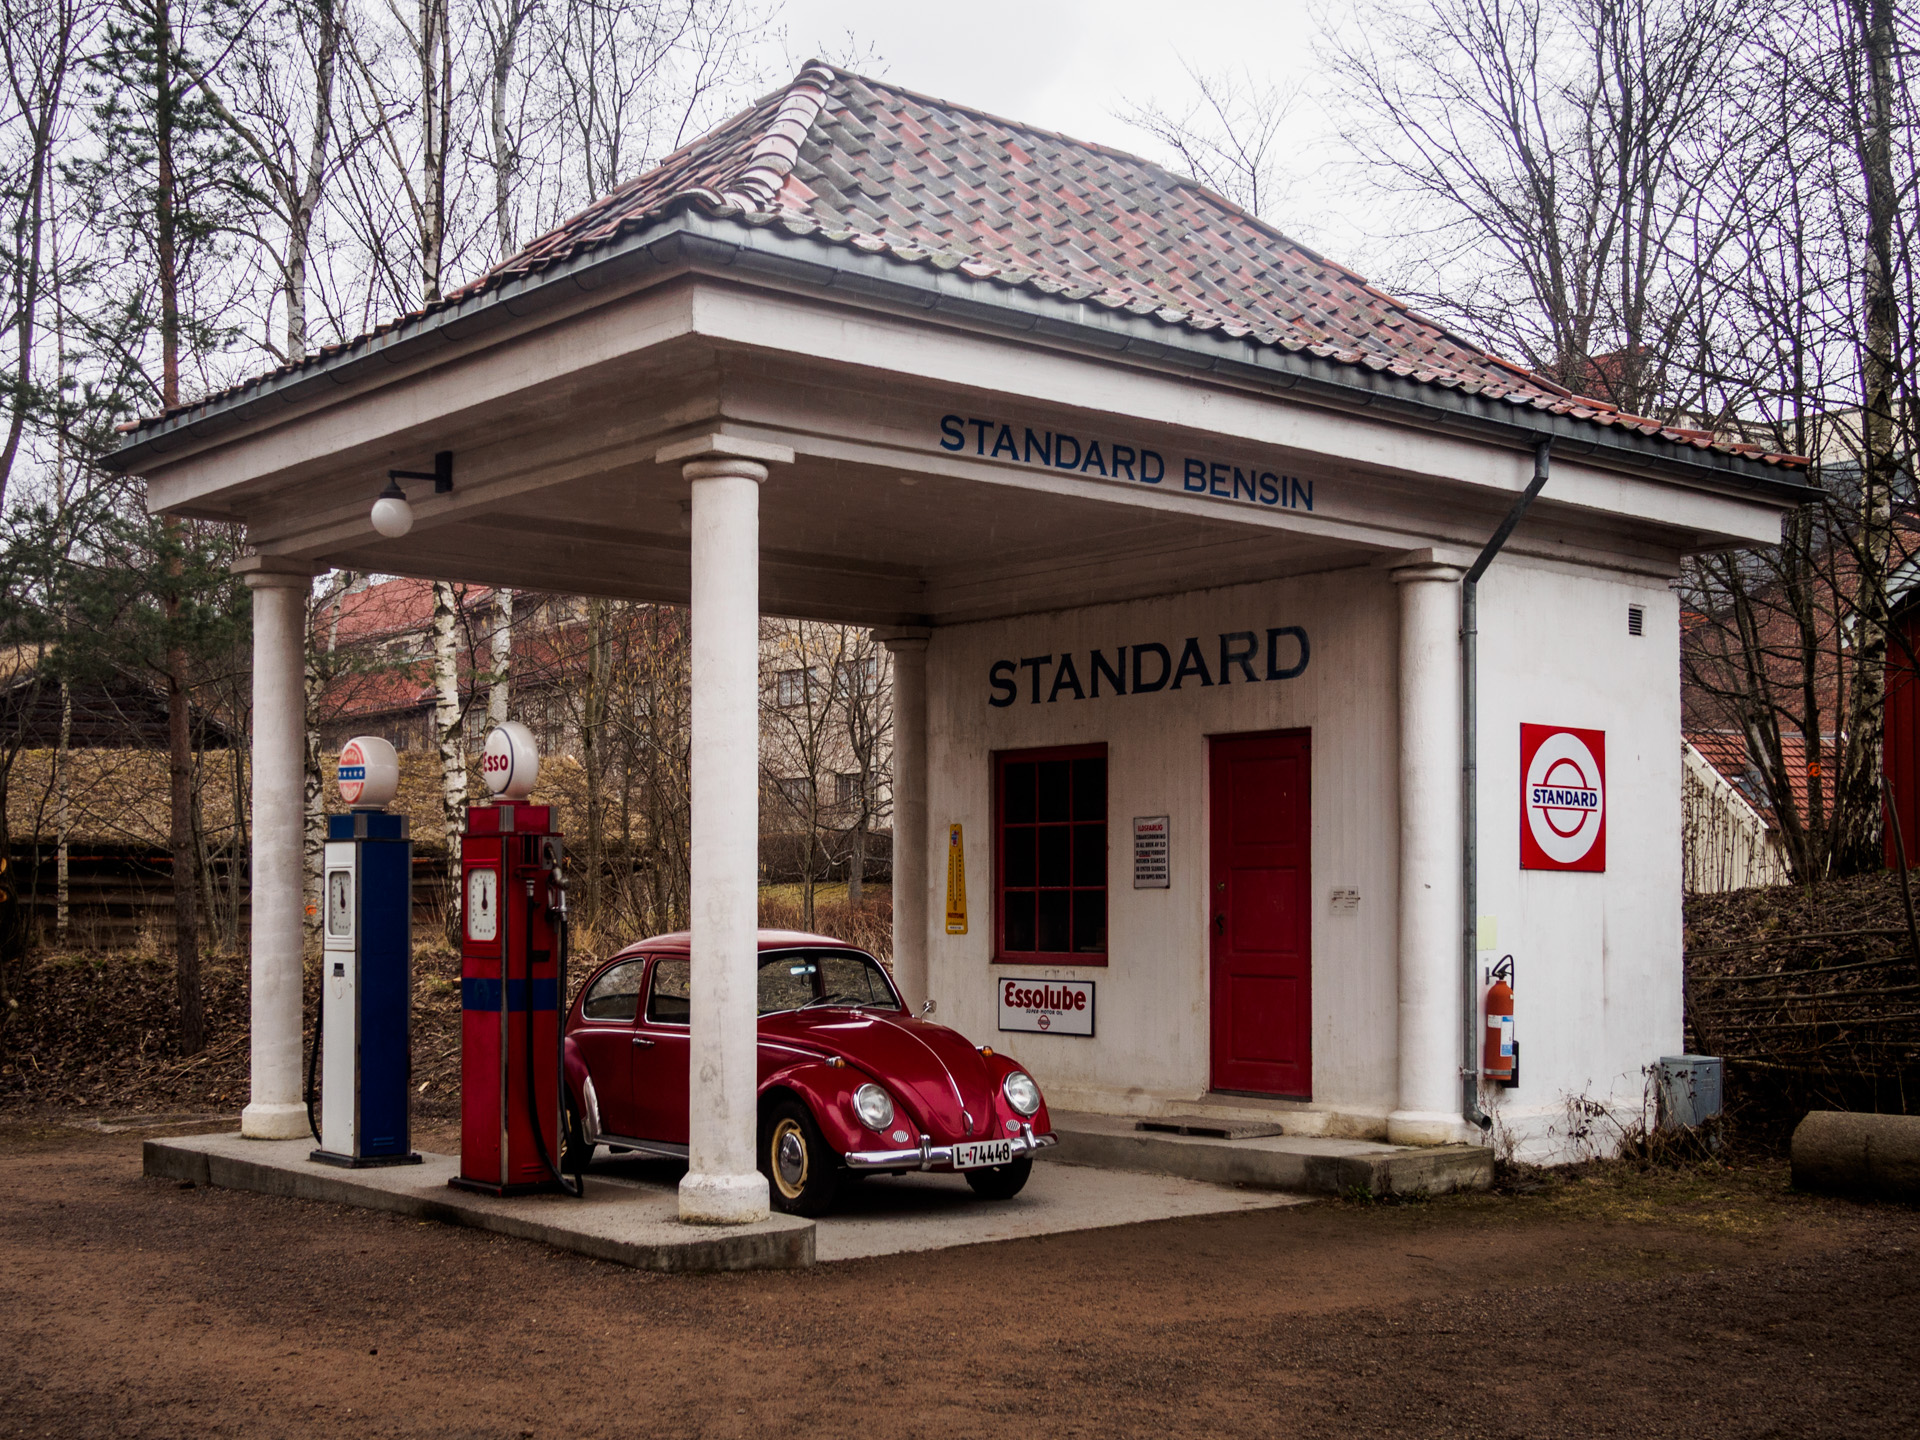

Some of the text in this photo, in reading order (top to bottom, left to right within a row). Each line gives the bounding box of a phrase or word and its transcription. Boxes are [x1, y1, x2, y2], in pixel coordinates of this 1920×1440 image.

[940, 415, 1314, 511] STANDARD BENSIN
[988, 625, 1311, 708] STANDARD
[1532, 788, 1598, 807] STANDARD
[1004, 981, 1087, 1011] Essolube
